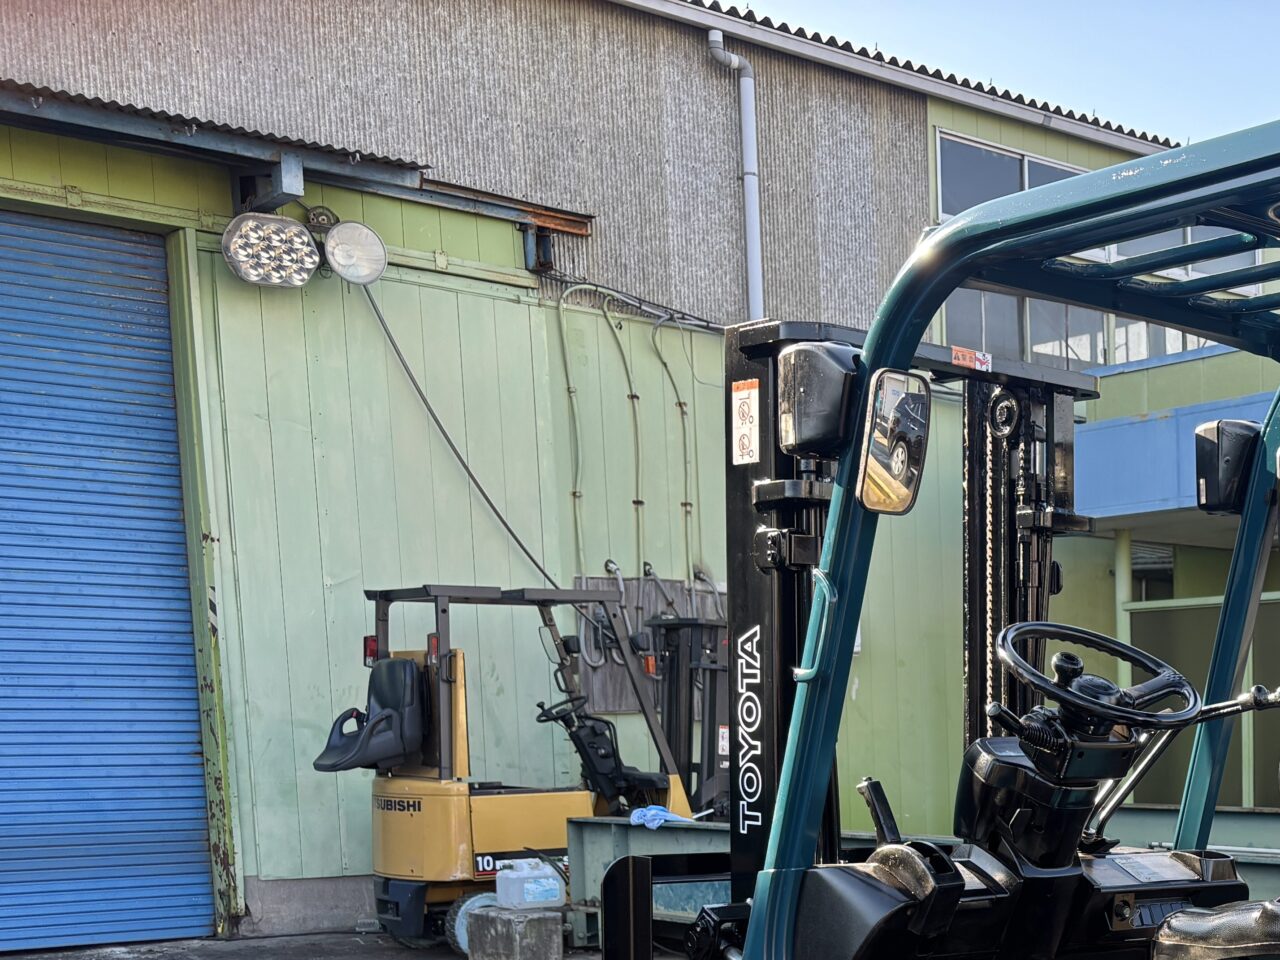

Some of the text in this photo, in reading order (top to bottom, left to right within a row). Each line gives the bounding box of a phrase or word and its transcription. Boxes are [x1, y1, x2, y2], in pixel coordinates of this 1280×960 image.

[738, 624, 762, 834] TOYOTA
[375, 797, 422, 812] SUBISHI
[476, 855, 494, 872] 10
